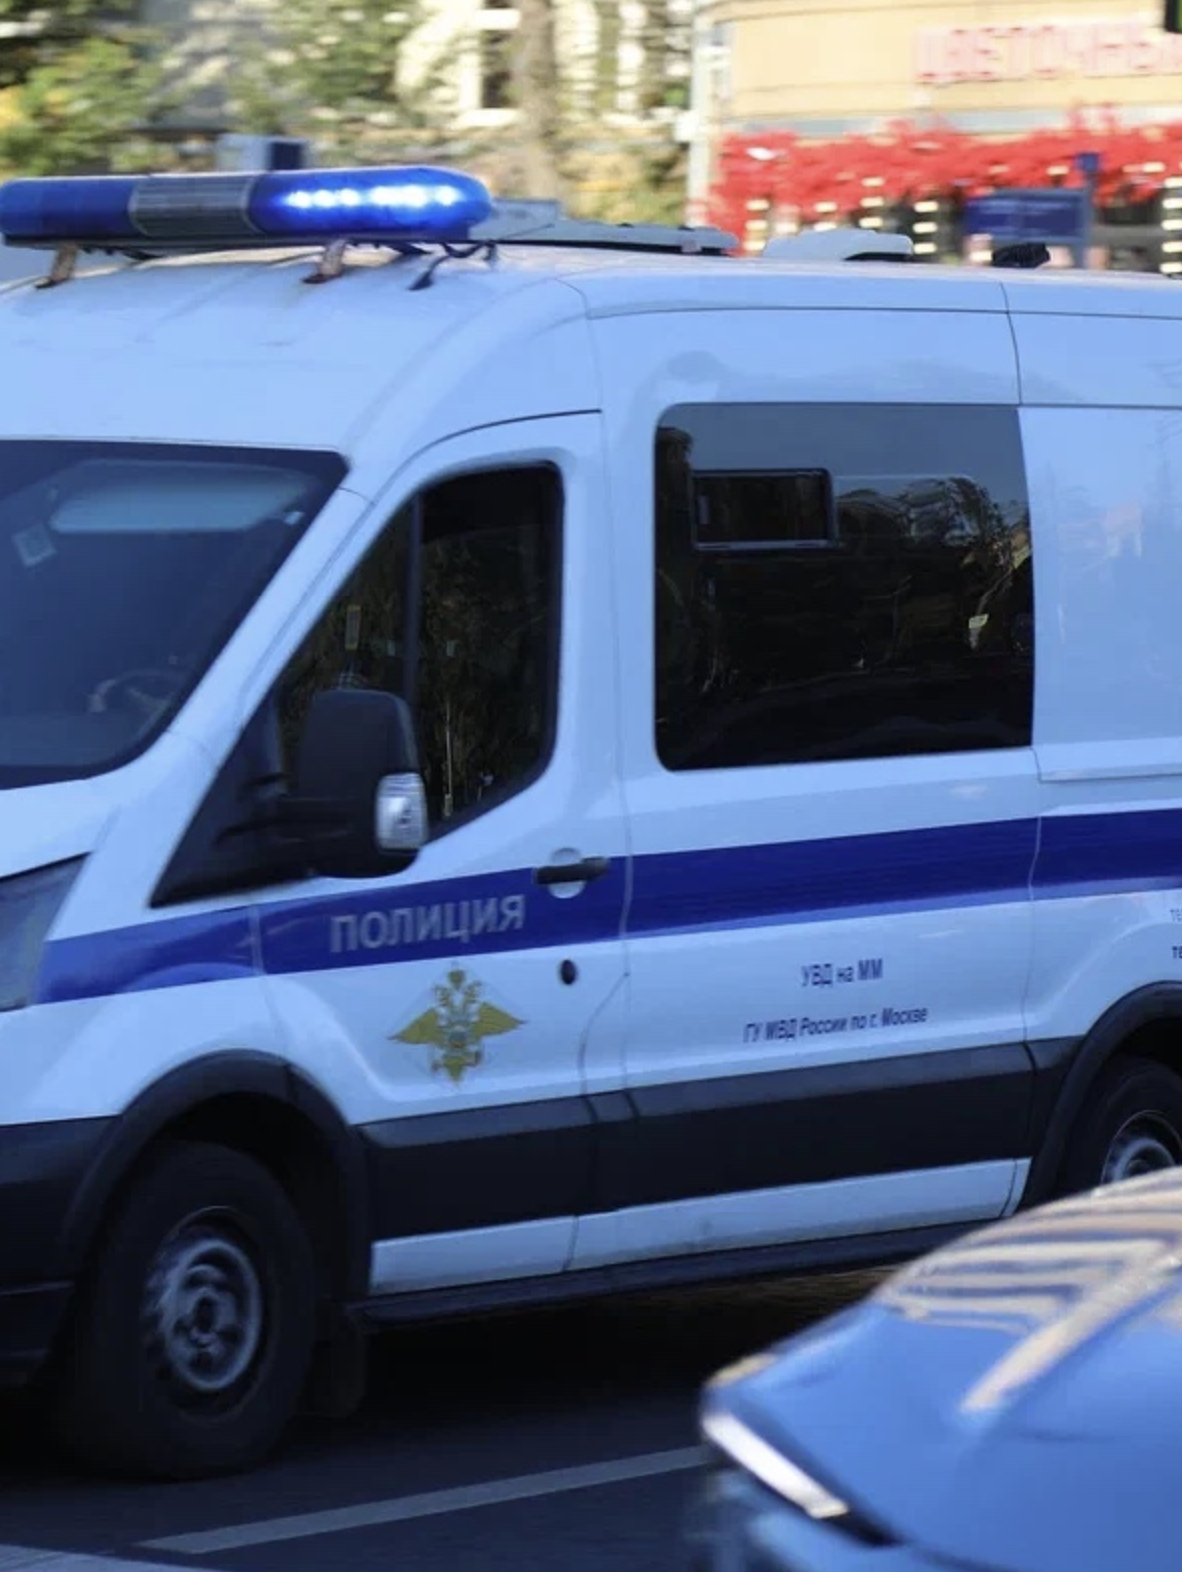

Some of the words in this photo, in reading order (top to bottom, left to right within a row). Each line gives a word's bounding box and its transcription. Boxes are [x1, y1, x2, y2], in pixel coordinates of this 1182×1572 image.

[330, 894, 526, 953] ПОЛИЦИЯ
[801, 963, 833, 987] УВД
[837, 966, 854, 983] на
[858, 957, 883, 981] ММ
[743, 1022, 763, 1043] ГУ
[765, 1018, 797, 1041] МВД
[799, 1017, 848, 1037] России
[850, 1014, 867, 1031] по
[881, 1007, 928, 1027] Москве
